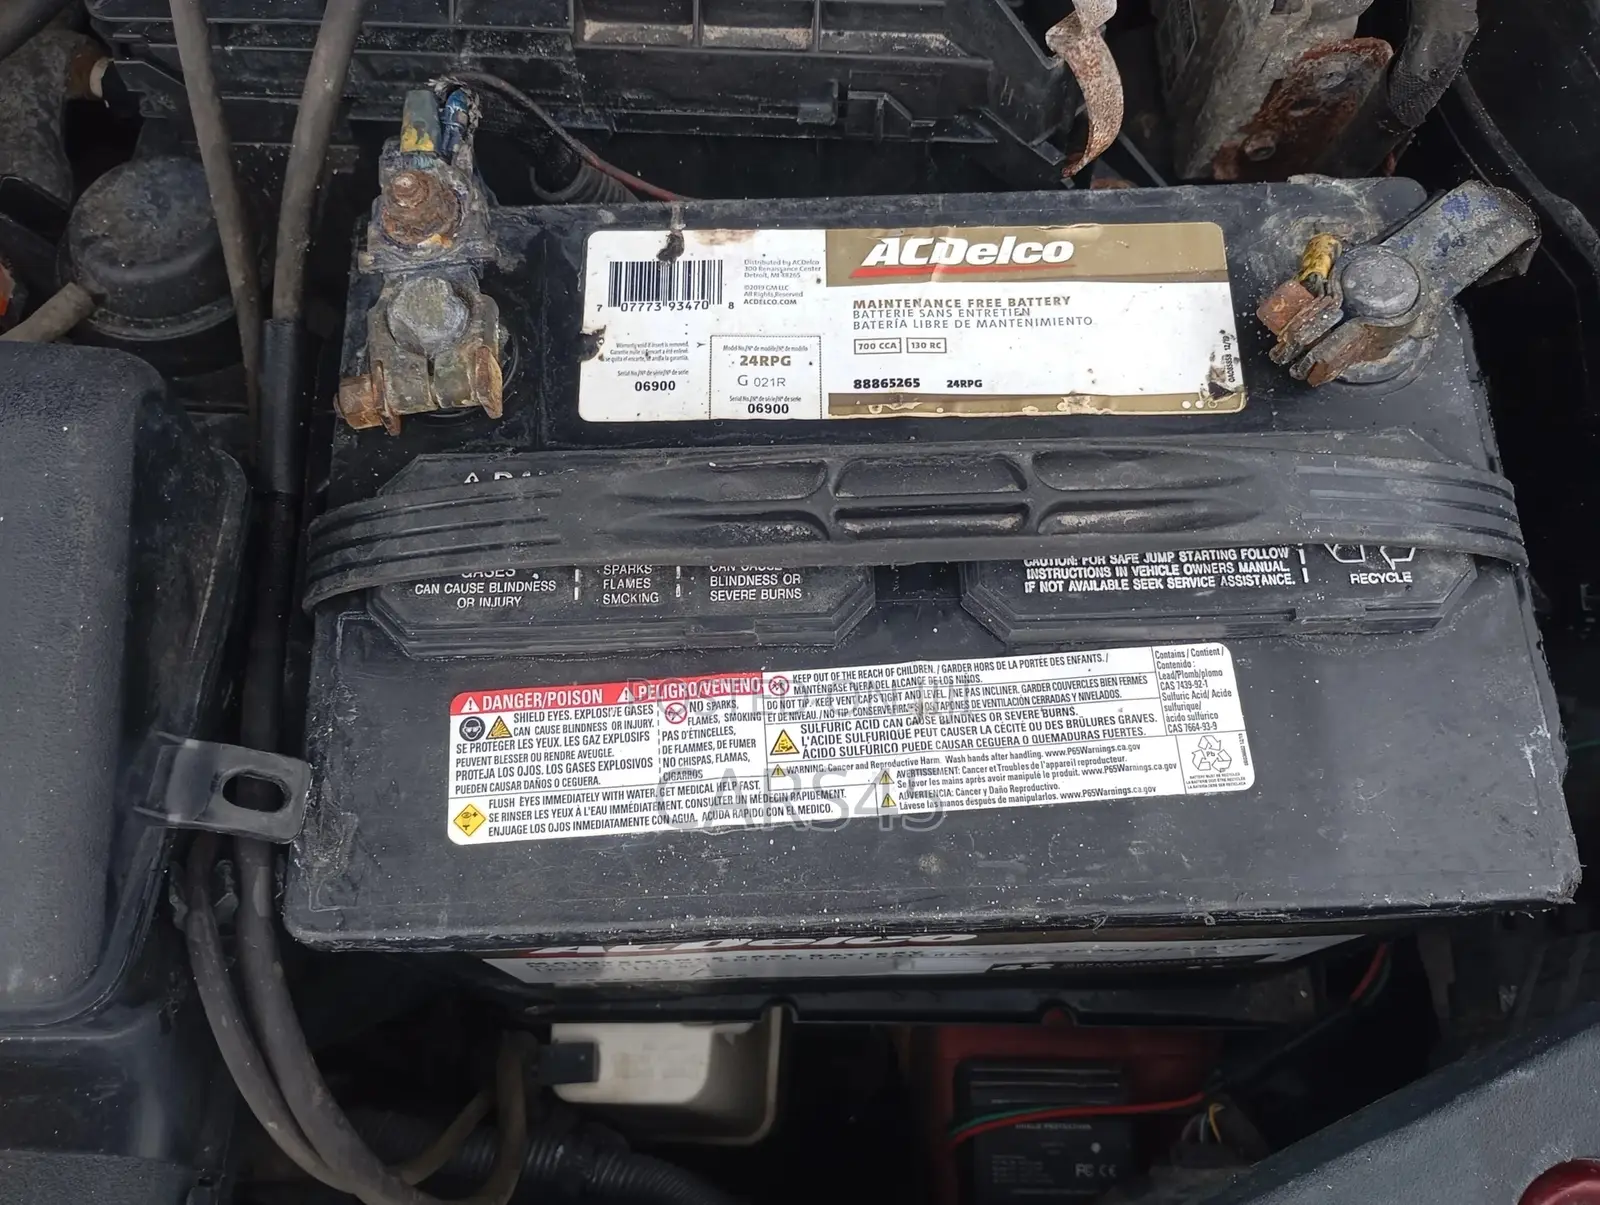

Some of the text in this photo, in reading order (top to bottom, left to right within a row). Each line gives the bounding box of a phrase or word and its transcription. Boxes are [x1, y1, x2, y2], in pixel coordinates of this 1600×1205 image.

[861, 236, 1075, 266] ACDelco
[596, 300, 735, 312] 7 07773 93470 8
[853, 296, 1071, 309] MAINTENANCE FREE BATTERY
[853, 308, 1031, 320] BATTERIE SANS ENTRETIEN
[853, 317, 1093, 330] BATERÍA LIBRE DE MANTENIMIENTO
[858, 342, 898, 351] 700 CCA
[911, 341, 942, 350] 130 RC
[740, 355, 791, 366] 24RPG
[635, 380, 676, 392] 06900
[737, 374, 786, 387] G 021R
[853, 378, 983, 389] 88865265 24RPG
[747, 403, 790, 414] 06900
[1024, 556, 1079, 567] CAUTION:
[1109, 553, 1139, 564] SAFE
[1143, 551, 1175, 563] JUMP
[1178, 549, 1237, 562] STARTING
[1240, 547, 1290, 560] FOLLOW
[603, 564, 653, 575] SPARKS
[1027, 561, 1291, 580] INSTRUCTIONS IN VEHICLE OWNERS MANUAL.
[603, 578, 652, 590] FLAMES
[710, 574, 801, 587] BLINDNESS OR
[1024, 574, 1296, 594] IF NOT AVAILABLE SEEK SERVICE ASSISTANCE.
[1350, 571, 1413, 585] RECYCLE
[415, 580, 557, 595] CAN CAUSE BLINDNESS
[602, 592, 660, 605] SMOKING
[710, 588, 803, 602] SEVERE BURNS
[457, 596, 522, 609] OR INJURY
[1154, 649, 1185, 660] Contains
[1190, 647, 1220, 658] Contient
[1156, 661, 1192, 671] Contenido
[1158, 669, 1224, 681] Lead/Plomb/plomo
[638, 679, 762, 699] PELIGRO/VENENO
[1160, 679, 1209, 691] CAS 7439-92-1
[482, 689, 603, 711] DANGER/POISON
[1161, 689, 1232, 702] Sulfuric Acid/ Acide
[689, 700, 739, 713] NO SPARKS,
[1164, 701, 1202, 713] sulfurique/
[513, 705, 654, 724] SHIELD EYES. EXPLOSIVE GASES
[688, 712, 762, 727] FLAMES, SMOKING
[801, 706, 1079, 735] SULFURIC ACID CAN CAUSE BLINDNES OR SEVERE BURNS.
[1167, 722, 1218, 734] CAS 7664-93-9
[456, 731, 650, 754] SE PROTEGER LES YEUX. LES GAZ EXPLOSIFS
[802, 727, 1147, 760] ÁCIDO SULFÚRICO PUEDE CAUSAR CEGUERA O QUEMADURAS FUERTES.
[662, 752, 751, 768] NO CHISPAS, FLAMAS,
[489, 780, 761, 809] FLUSH EYES IMMEDIATELY WITH WATER. GET MEDICAL HELP FAST.
[997, 795, 1007, 804] de
[1008, 792, 1058, 804] manipularlos.
[1059, 786, 1157, 800] www.P65Warnings.ca.gov
